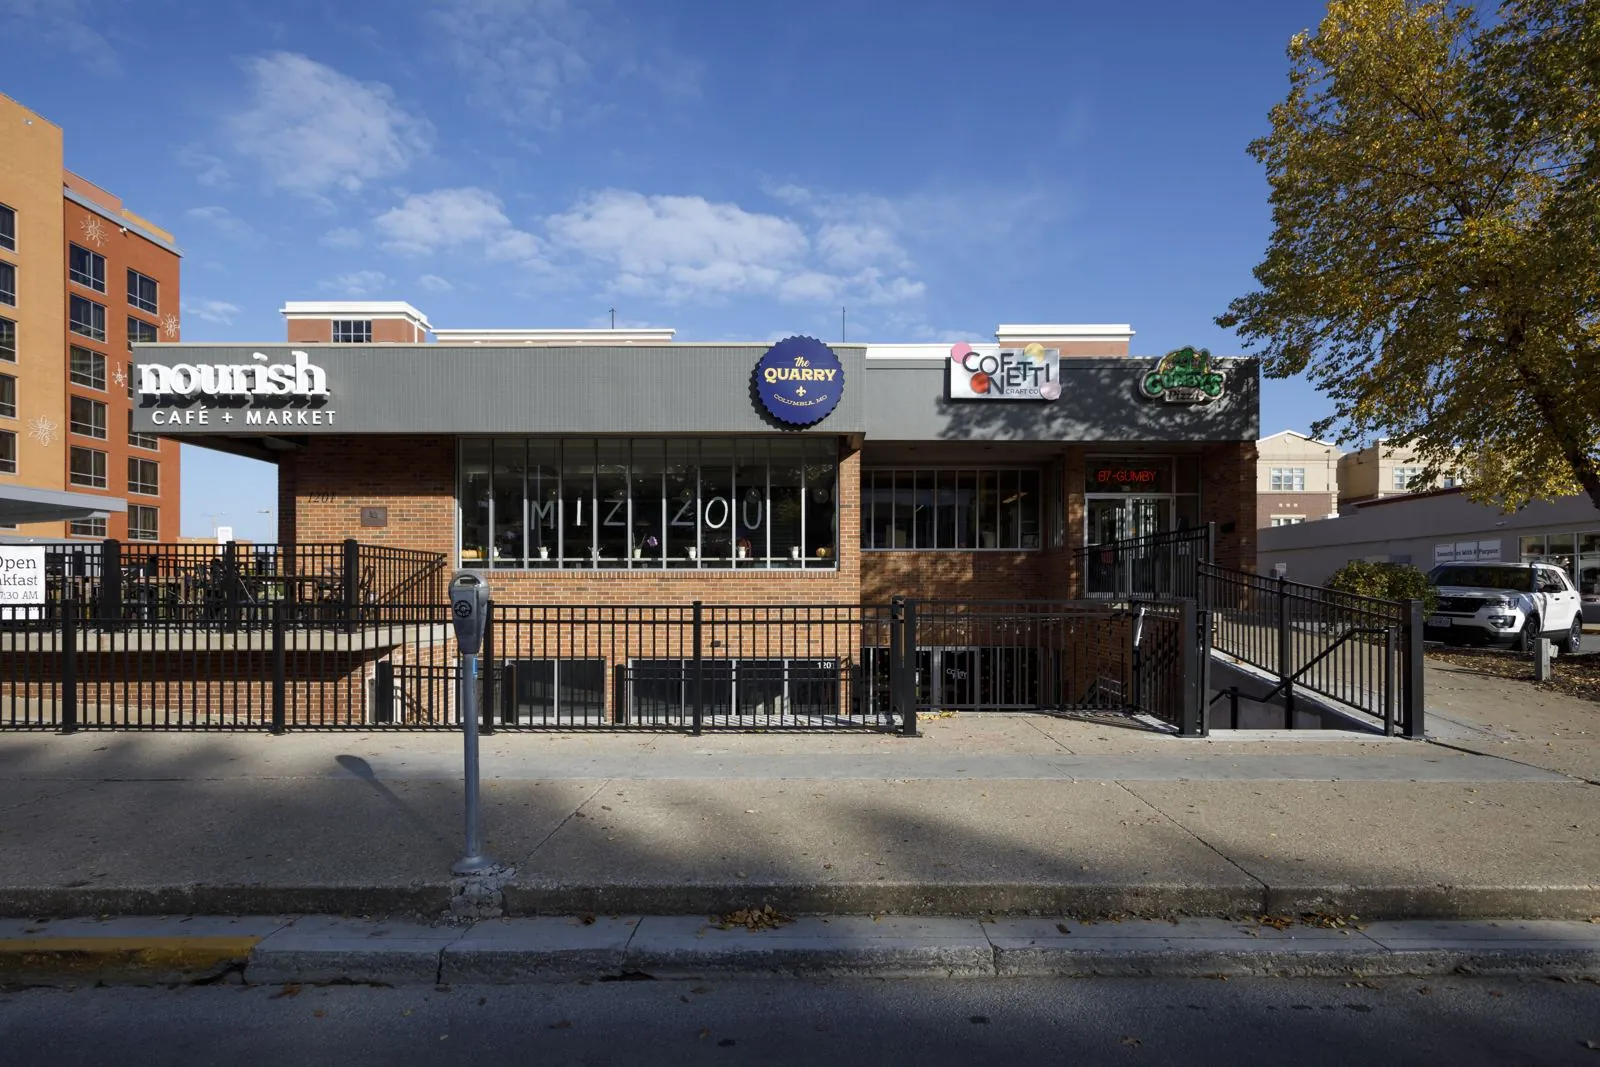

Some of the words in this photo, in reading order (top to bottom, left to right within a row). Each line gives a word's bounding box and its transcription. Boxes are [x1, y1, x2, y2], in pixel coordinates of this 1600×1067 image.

[793, 356, 810, 368] the
[137, 350, 331, 396] nourish
[764, 367, 836, 384] QUARRY
[152, 405, 209, 425] CAFÉ
[246, 410, 336, 425] MARKET
[0, 556, 37, 572] pen
[22, 591, 39, 600] AM
